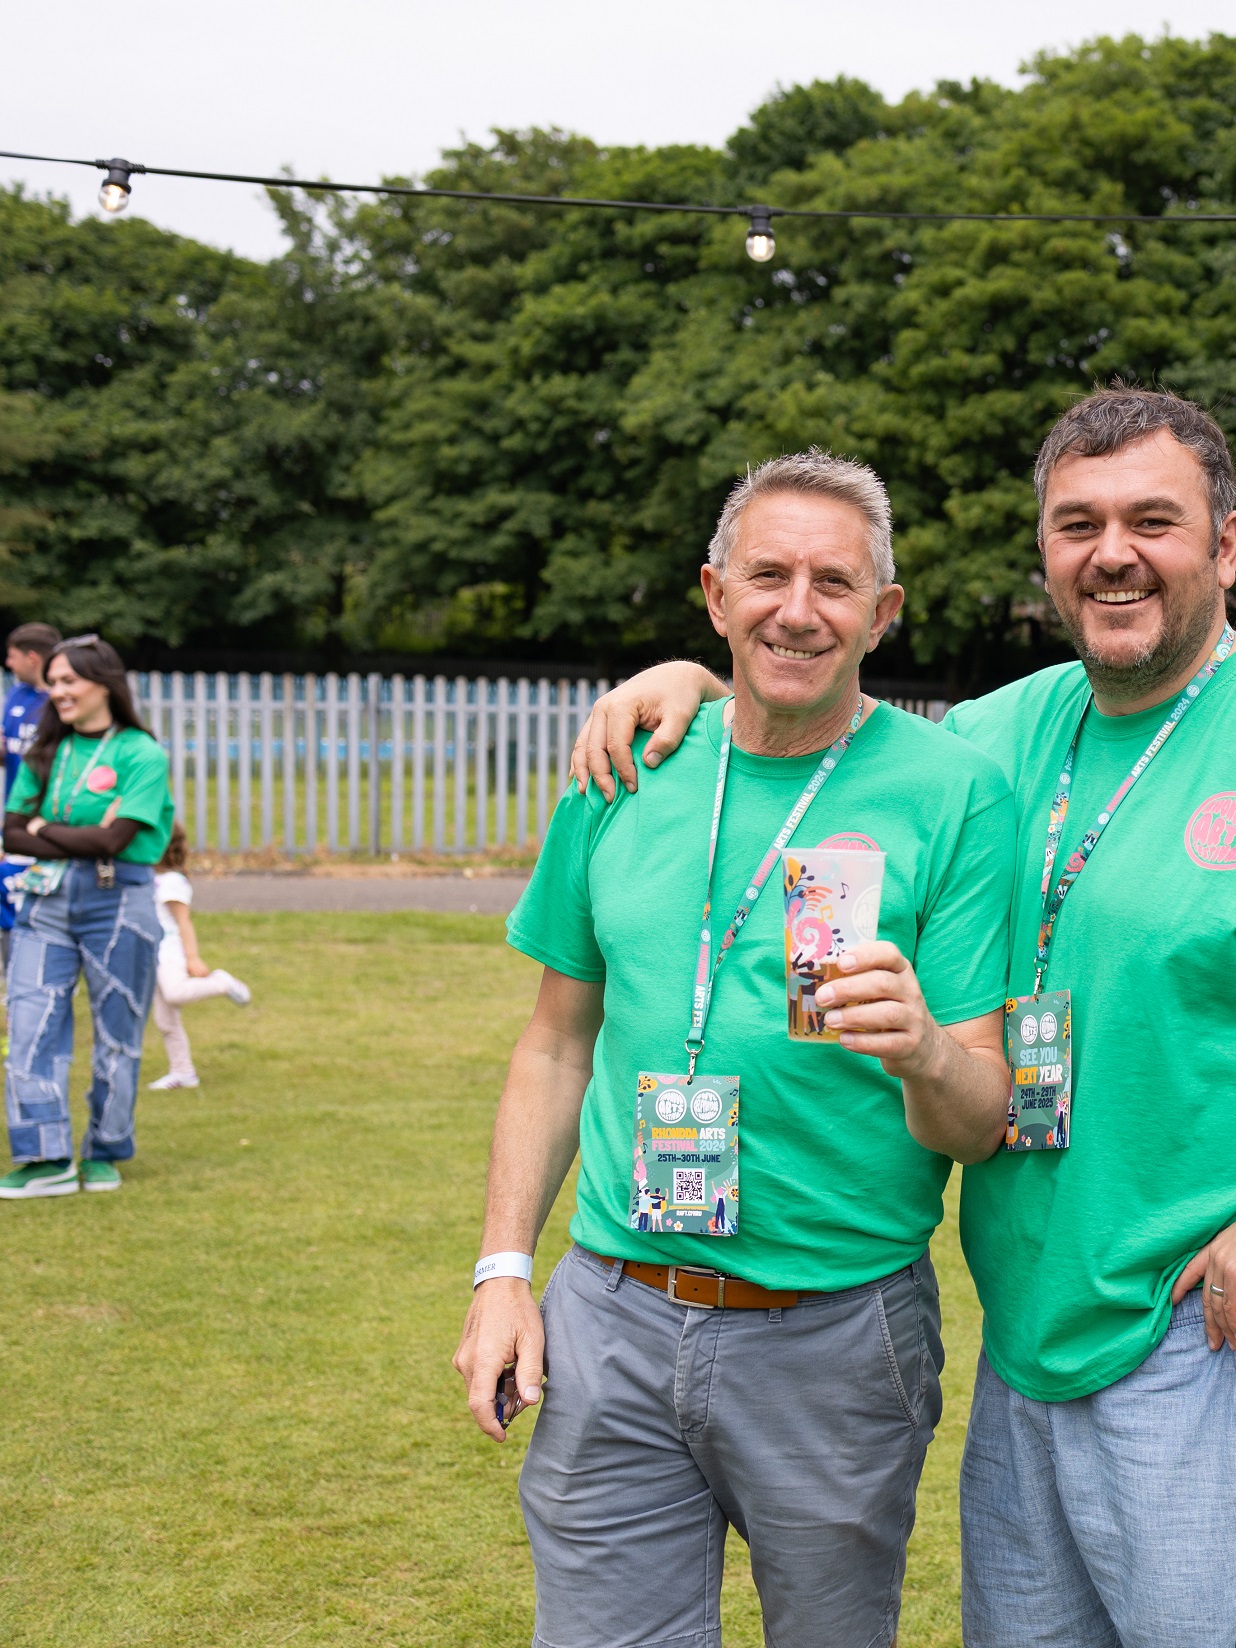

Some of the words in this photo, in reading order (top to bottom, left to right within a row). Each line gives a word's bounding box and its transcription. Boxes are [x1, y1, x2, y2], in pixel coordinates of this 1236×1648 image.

[1130, 755, 1149, 778] ARTS
[1145, 720, 1175, 757] FESTIVAL
[1171, 697, 1190, 720] 2024
[713, 779, 724, 818] FESTIVAL
[773, 828, 792, 849] ARTS
[786, 791, 814, 828] FESTIVAL
[808, 769, 827, 791] 2024
[710, 817, 719, 840] ARTS
[694, 984, 706, 1009] ARTS
[1020, 1048, 1038, 1066] SEE
[1039, 1046, 1058, 1064] YOU
[1015, 1067, 1038, 1085] NEXT
[1039, 1064, 1063, 1083] YEAR
[1020, 1088, 1036, 1099] 24TH
[1041, 1086, 1057, 1097] 29TH
[658, 1099, 684, 1115] ARTS
[1022, 1099, 1037, 1110] JUNE
[1038, 1097, 1054, 1109] 2025
[651, 1127, 698, 1140] RHONDDA
[699, 1127, 726, 1140] ARTS
[651, 1140, 698, 1152] FESTIVAL
[699, 1140, 726, 1152] 2024
[701, 1154, 721, 1163] JUNE
